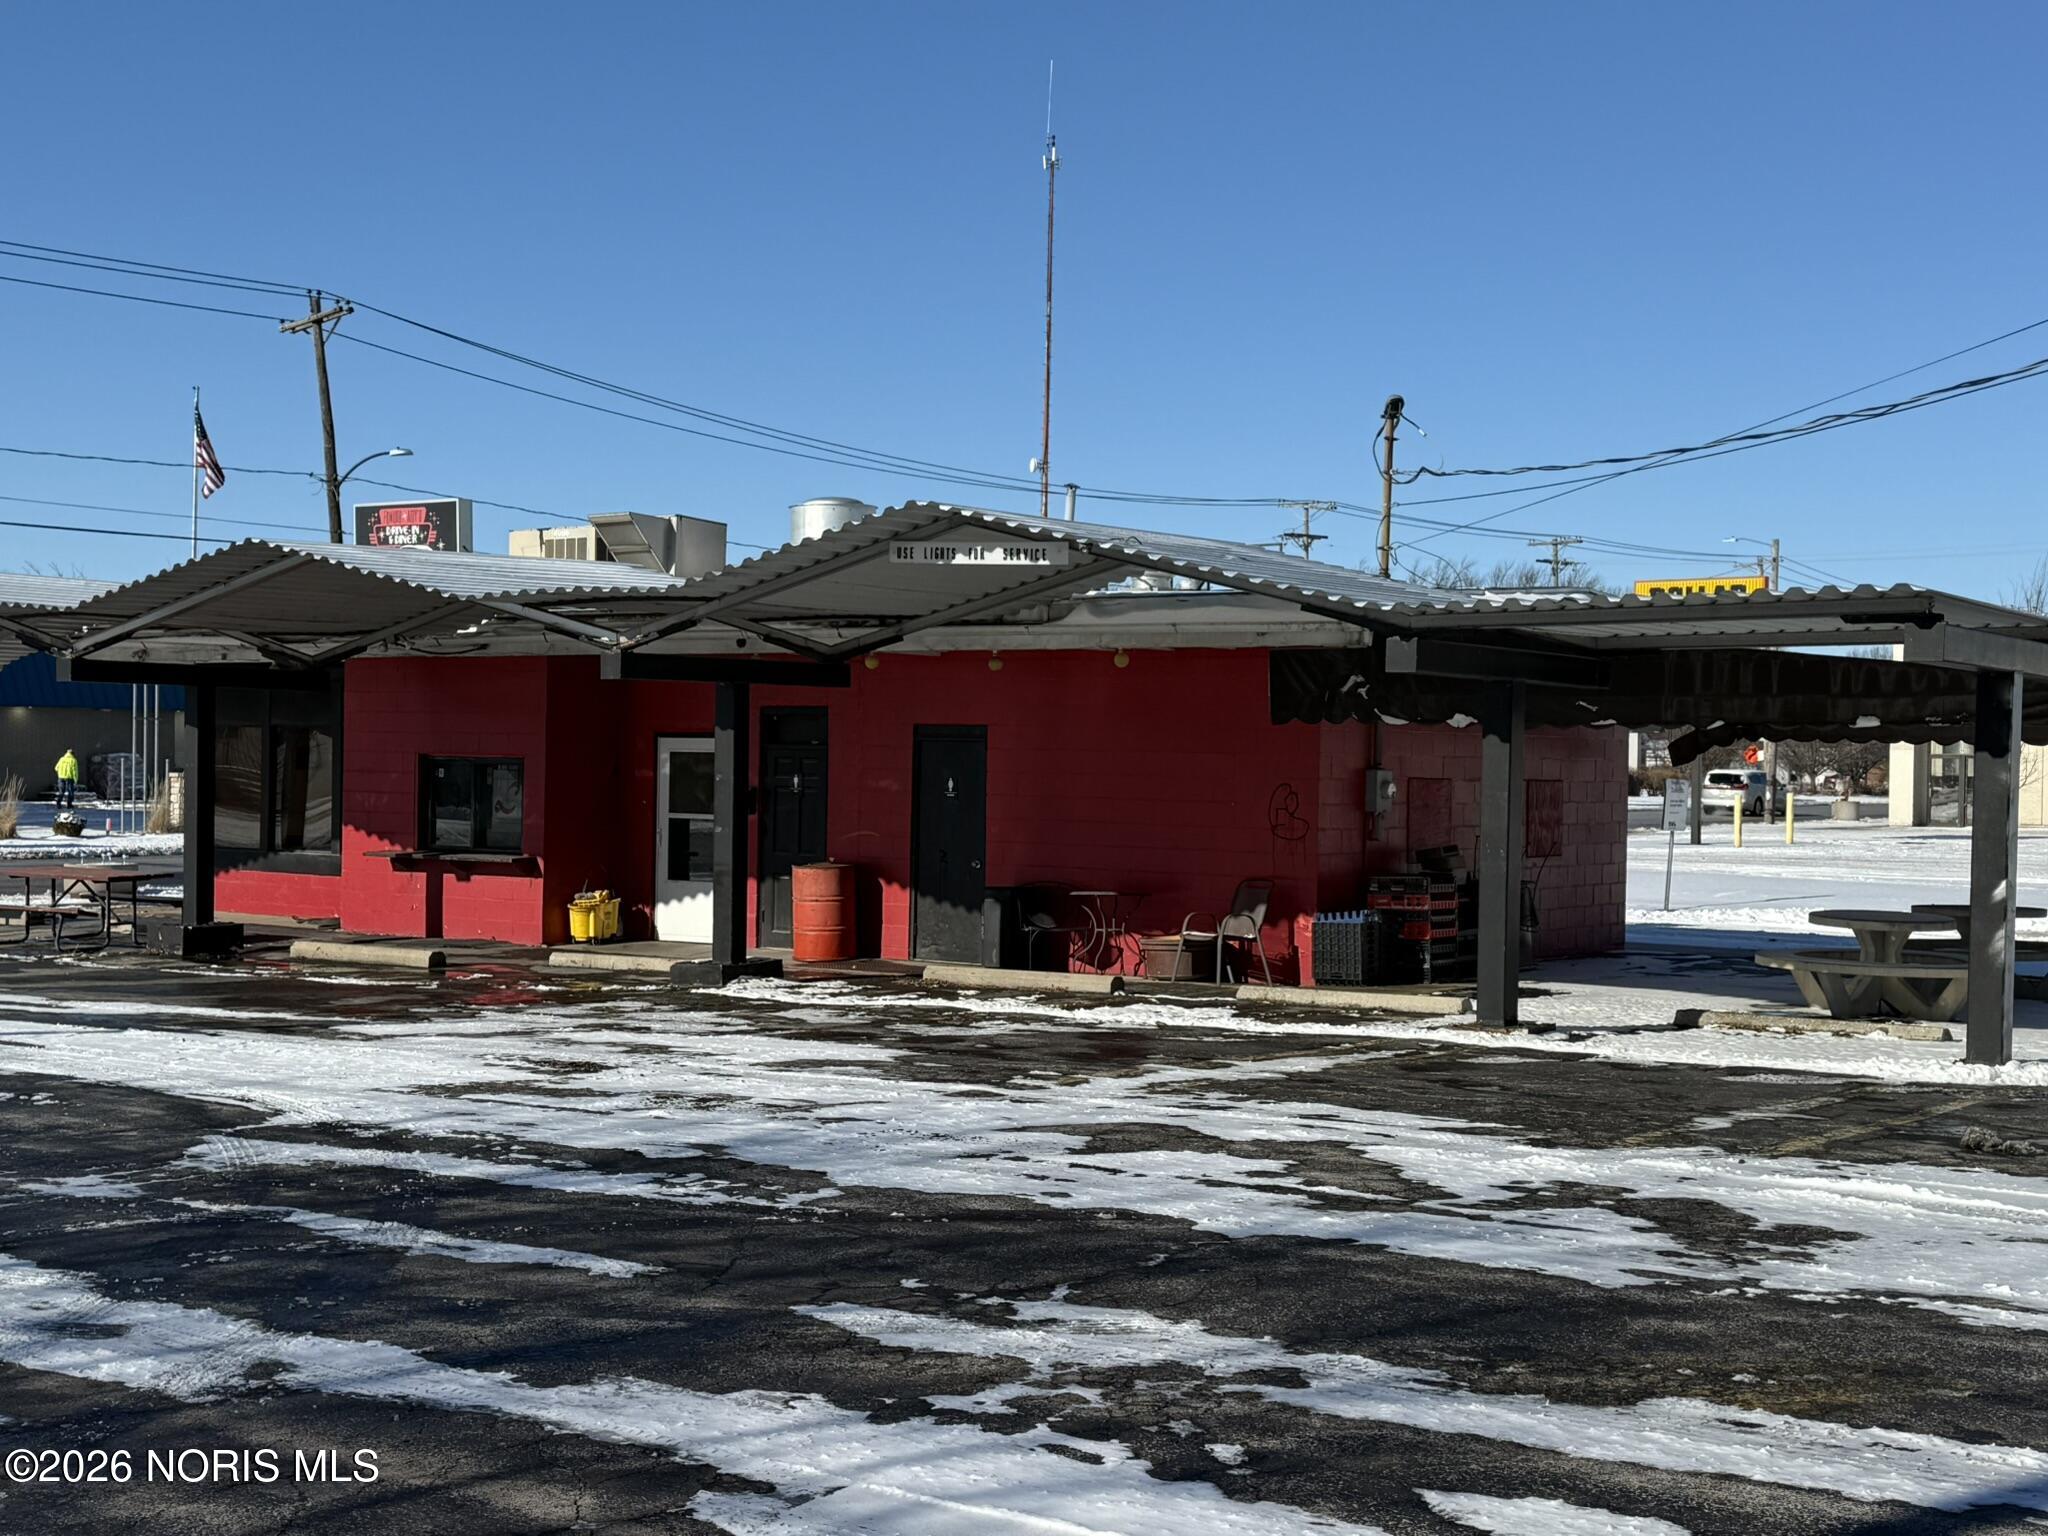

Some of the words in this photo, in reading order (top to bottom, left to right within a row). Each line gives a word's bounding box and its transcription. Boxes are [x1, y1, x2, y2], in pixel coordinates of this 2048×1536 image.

[896, 546, 914, 560] USE
[923, 547, 957, 560] LIGHTS
[968, 547, 985, 560] FOR
[1003, 547, 1047, 561] SERVICE
